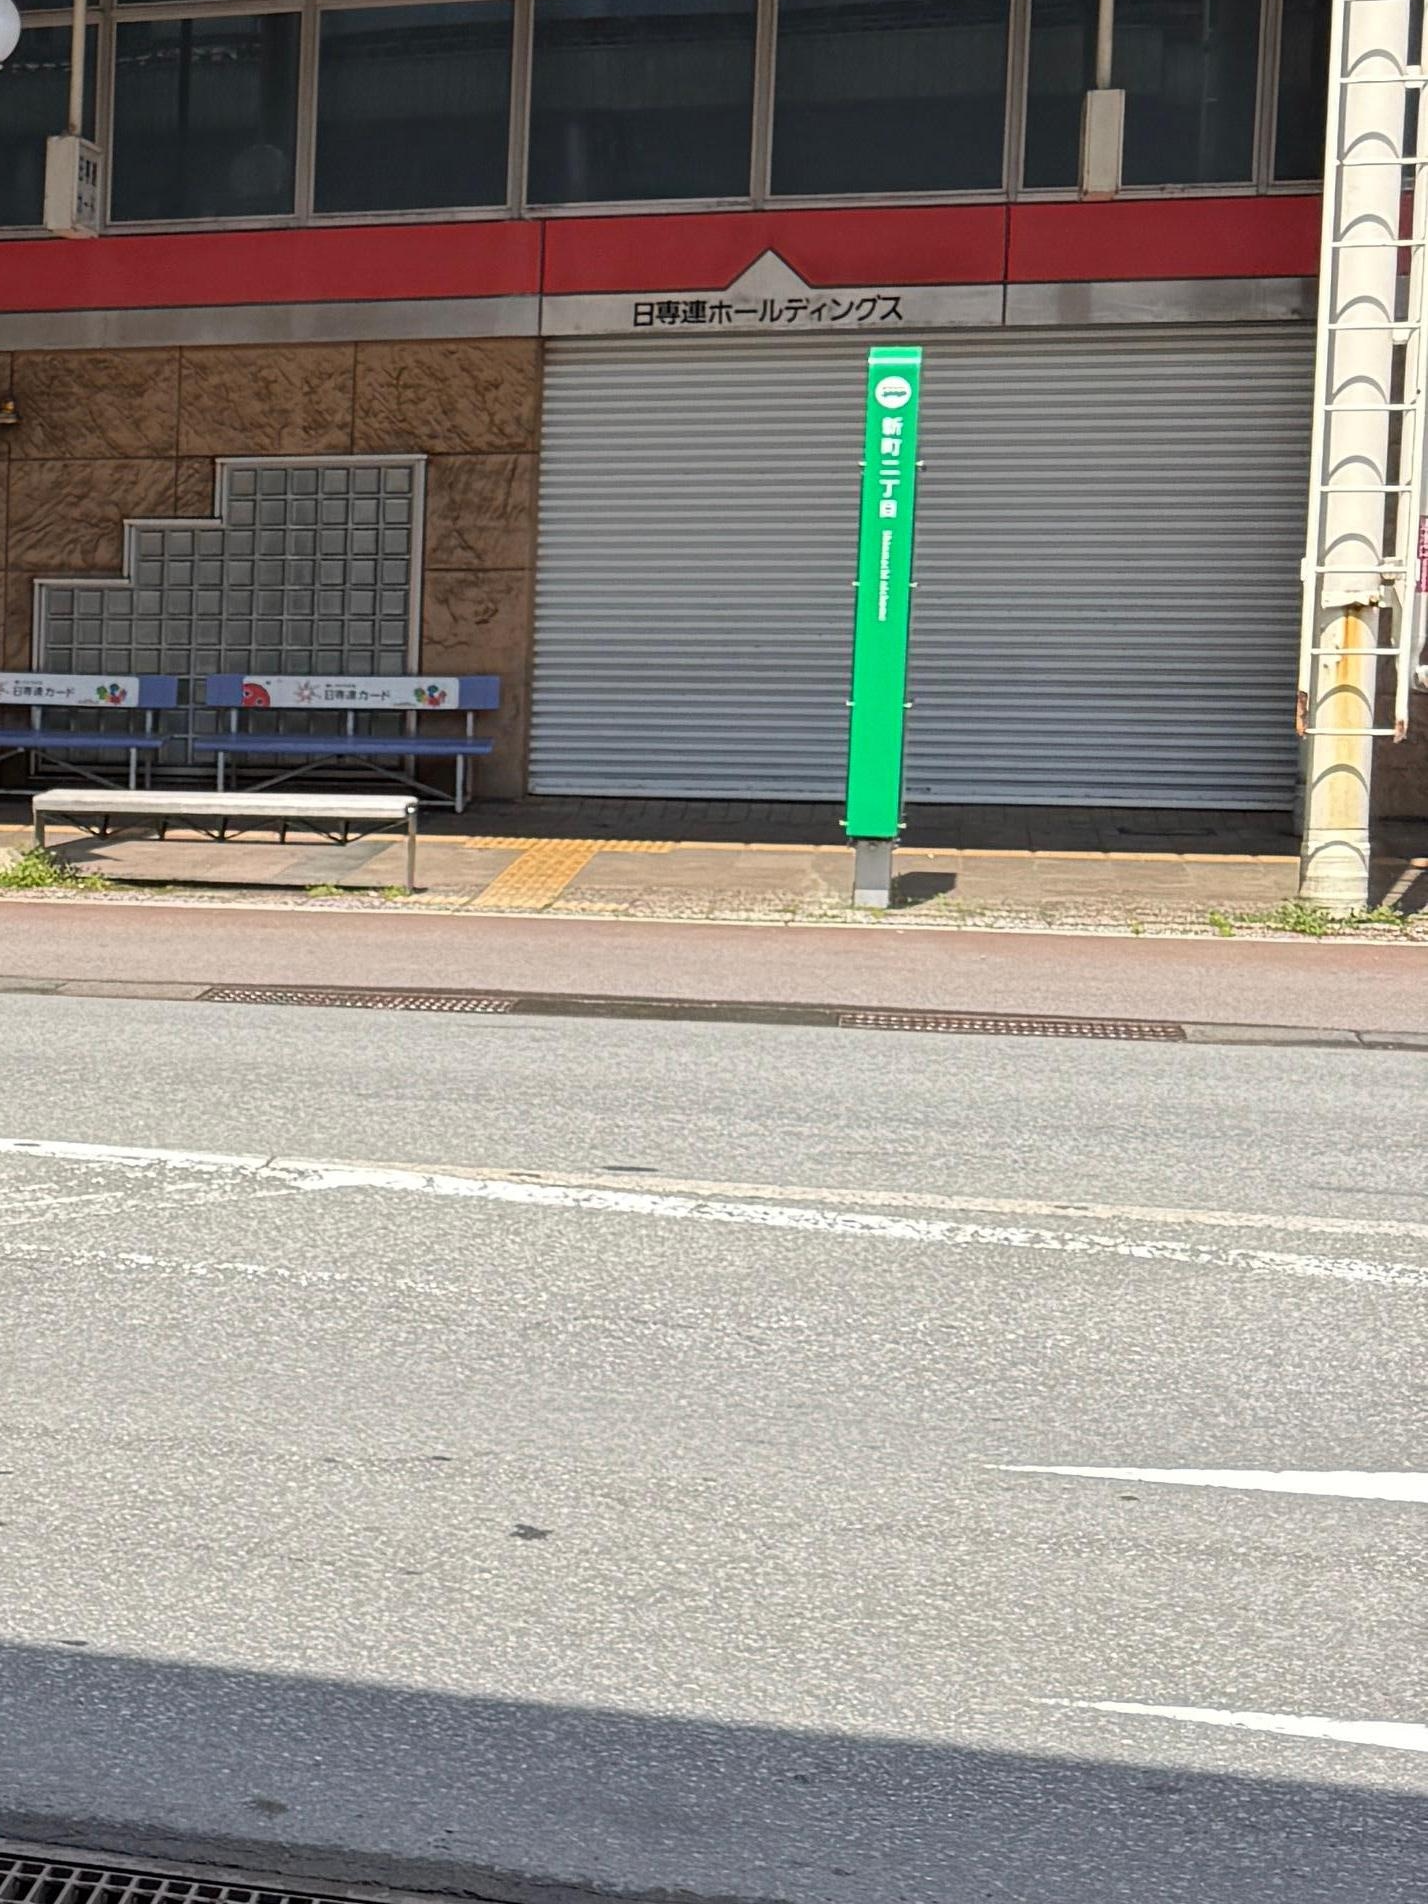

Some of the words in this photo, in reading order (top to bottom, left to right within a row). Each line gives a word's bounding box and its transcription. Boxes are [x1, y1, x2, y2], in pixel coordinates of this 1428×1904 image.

[632, 293, 904, 328] 日専連ホールディングス
[878, 416, 904, 519] 新町二丁目
